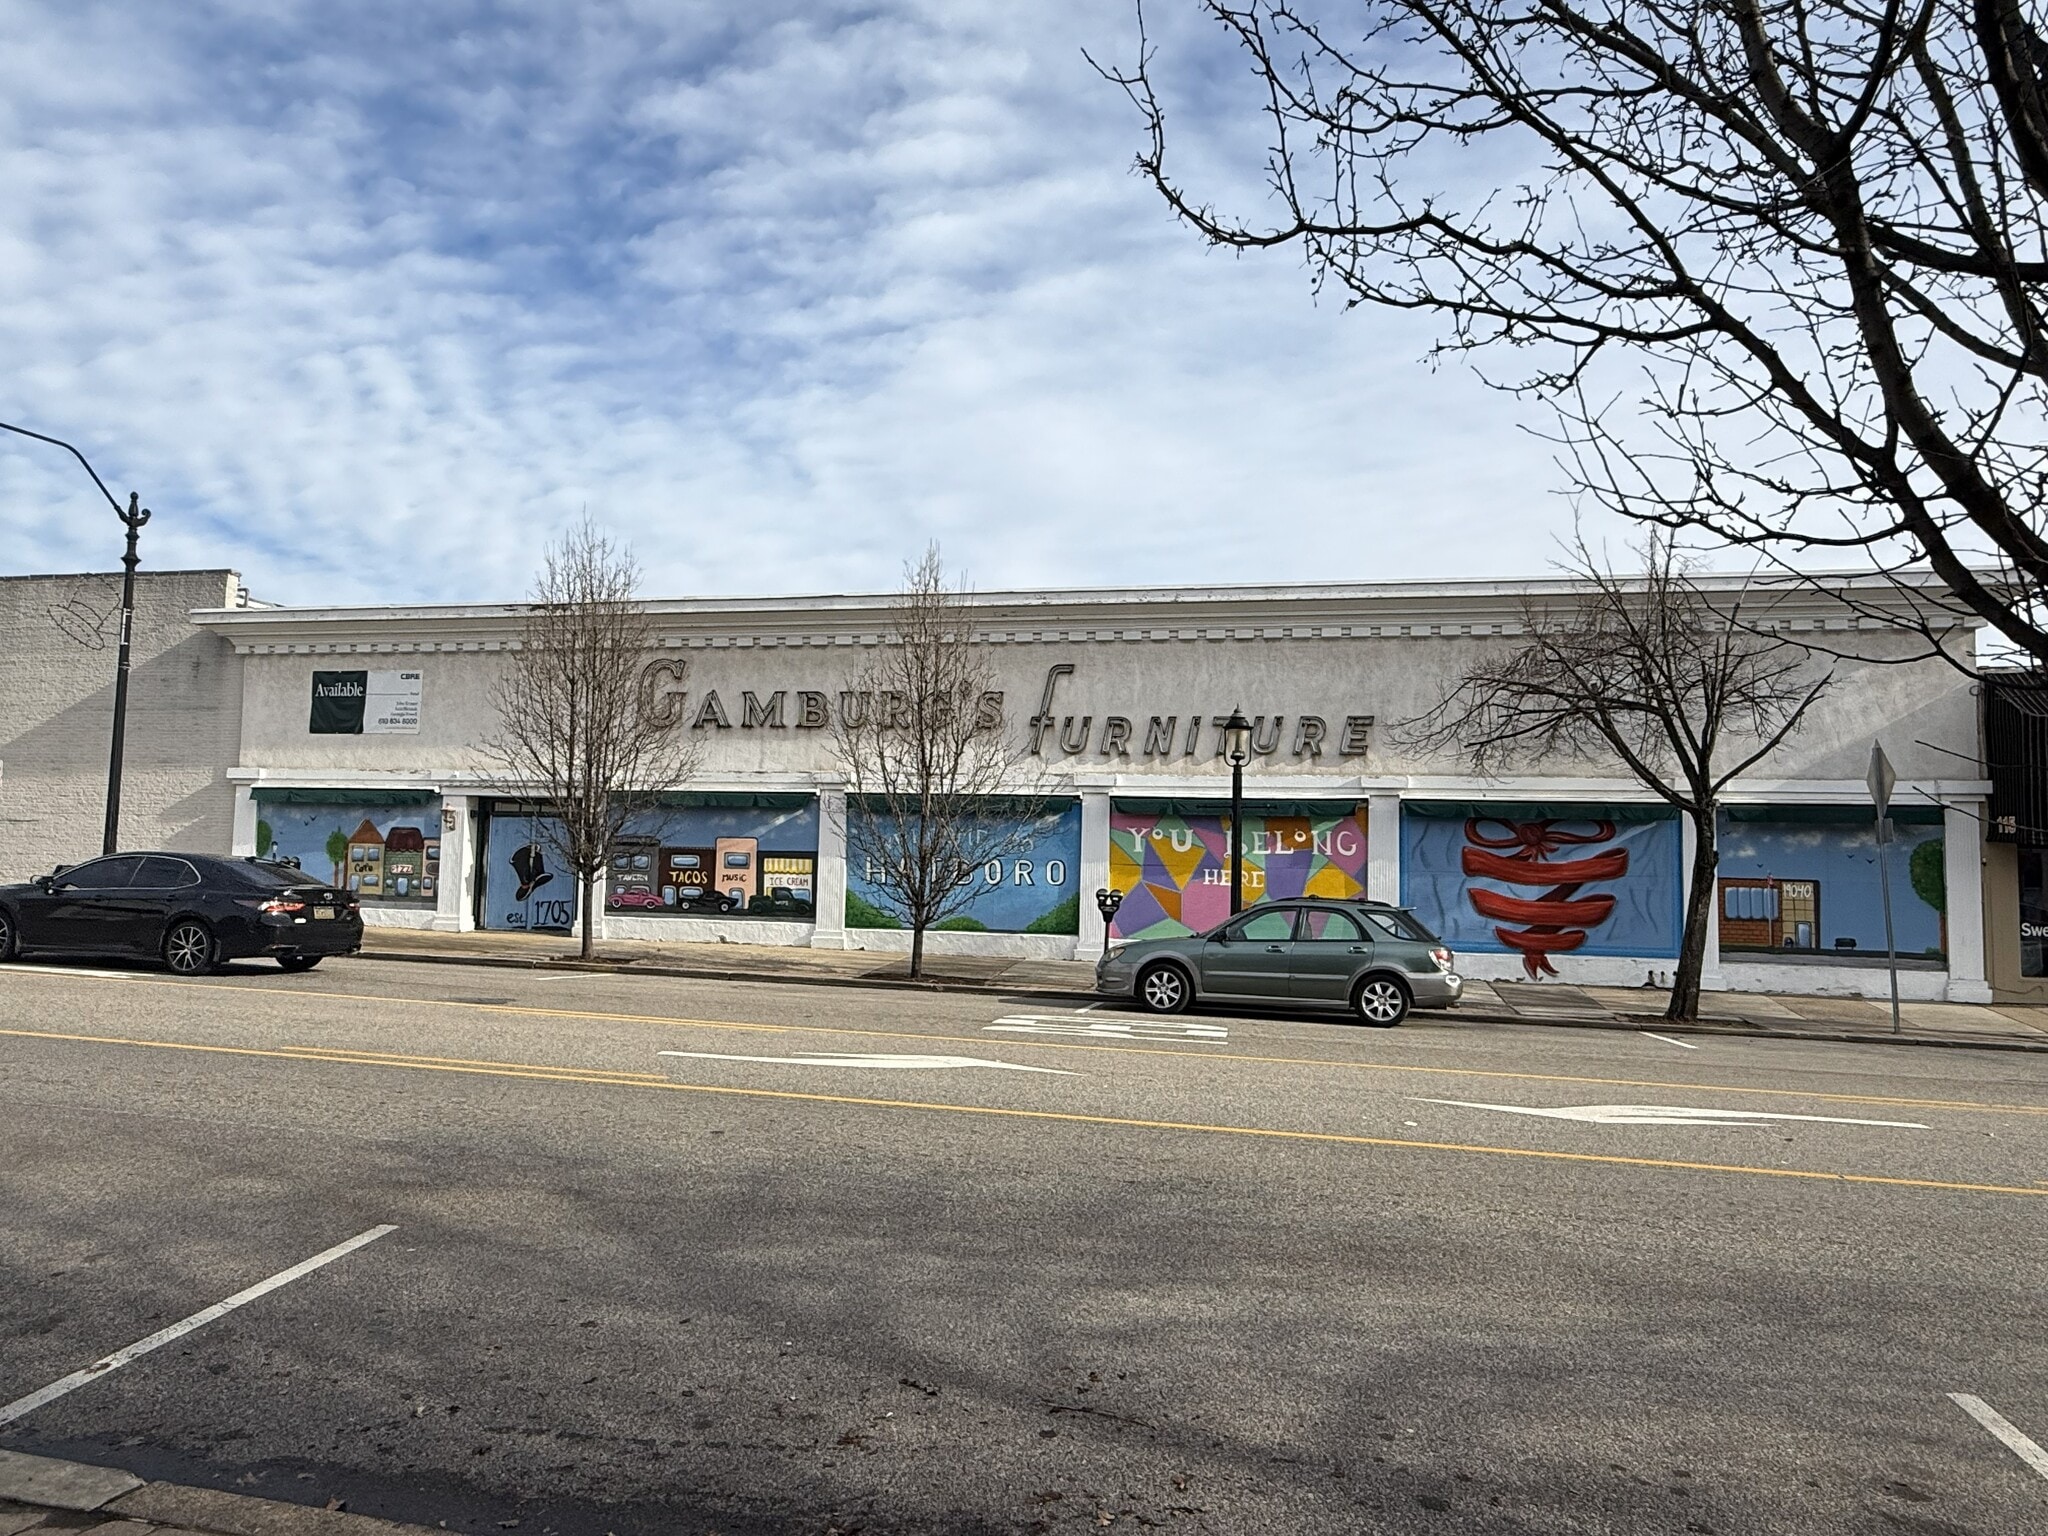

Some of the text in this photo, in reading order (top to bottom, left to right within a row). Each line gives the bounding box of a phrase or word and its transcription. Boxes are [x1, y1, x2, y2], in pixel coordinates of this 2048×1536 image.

[315, 682, 364, 697] Available
[1997, 816, 2016, 834] 115
[1127, 827, 1193, 852] YOU
[617, 874, 648, 882] TAVERN
[669, 871, 708, 884] TACOS
[769, 876, 809, 886] ICE CREAM
[1203, 869, 1265, 888] HERE
[1783, 883, 1811, 898] 19040
[534, 900, 572, 925] 1705
